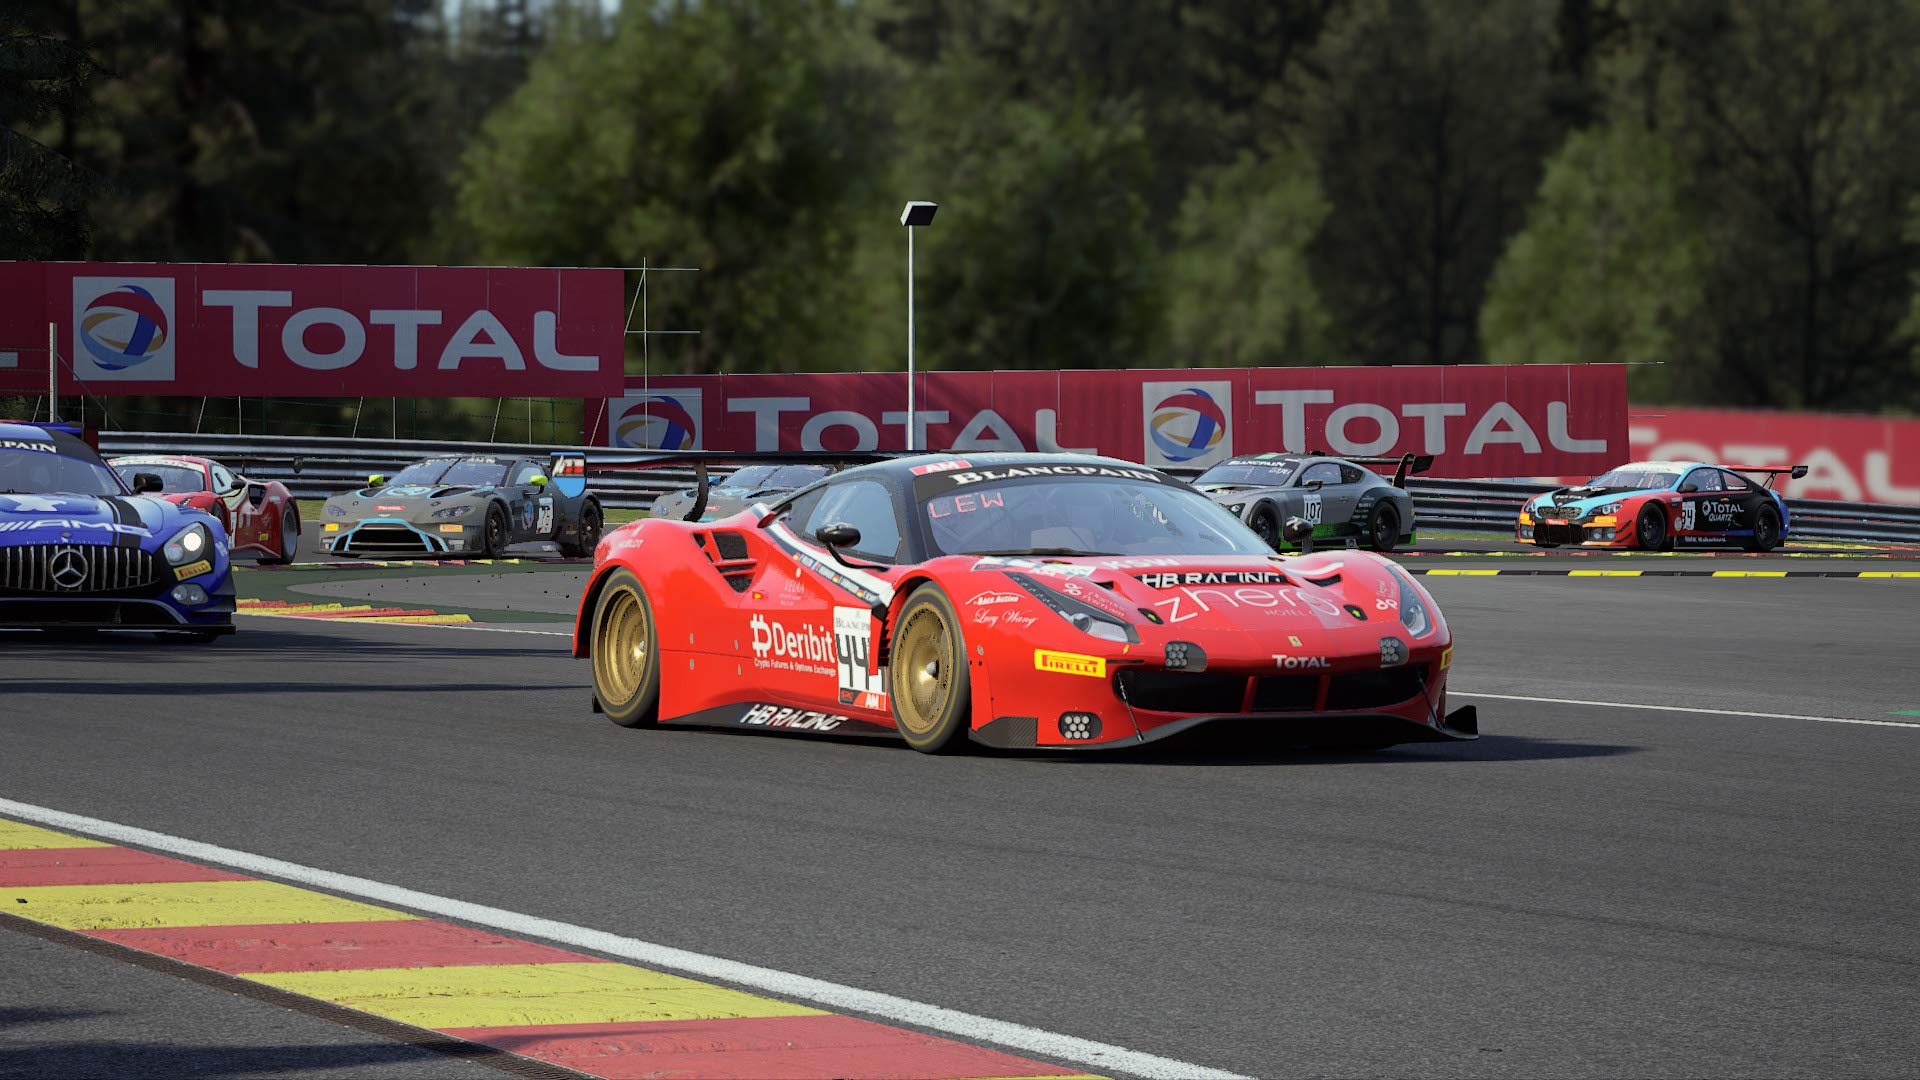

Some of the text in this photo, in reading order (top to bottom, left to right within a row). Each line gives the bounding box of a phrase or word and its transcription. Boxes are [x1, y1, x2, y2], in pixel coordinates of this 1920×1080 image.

[202, 290, 599, 371] TOTAL
[727, 397, 1098, 455] TOTAL
[1255, 389, 1607, 456] TOTAL
[926, 461, 960, 473] AM
[950, 466, 1161, 485] BLANCPAIN
[929, 492, 1004, 518] LEW
[1304, 502, 1321, 520] 107
[1711, 502, 1744, 513] TOTAL
[177, 562, 208, 578] PIRELLI
[1101, 557, 1180, 570] KSW
[1141, 571, 1281, 588] HB RACING
[1154, 586, 1339, 623] zhero
[1001, 609, 1039, 629] Wang
[772, 621, 836, 663] Deribit
[1042, 654, 1099, 674] PIRELLI
[1272, 654, 1331, 669] TOTAL
[865, 693, 879, 709] AM
[740, 703, 849, 731] HB RACING
